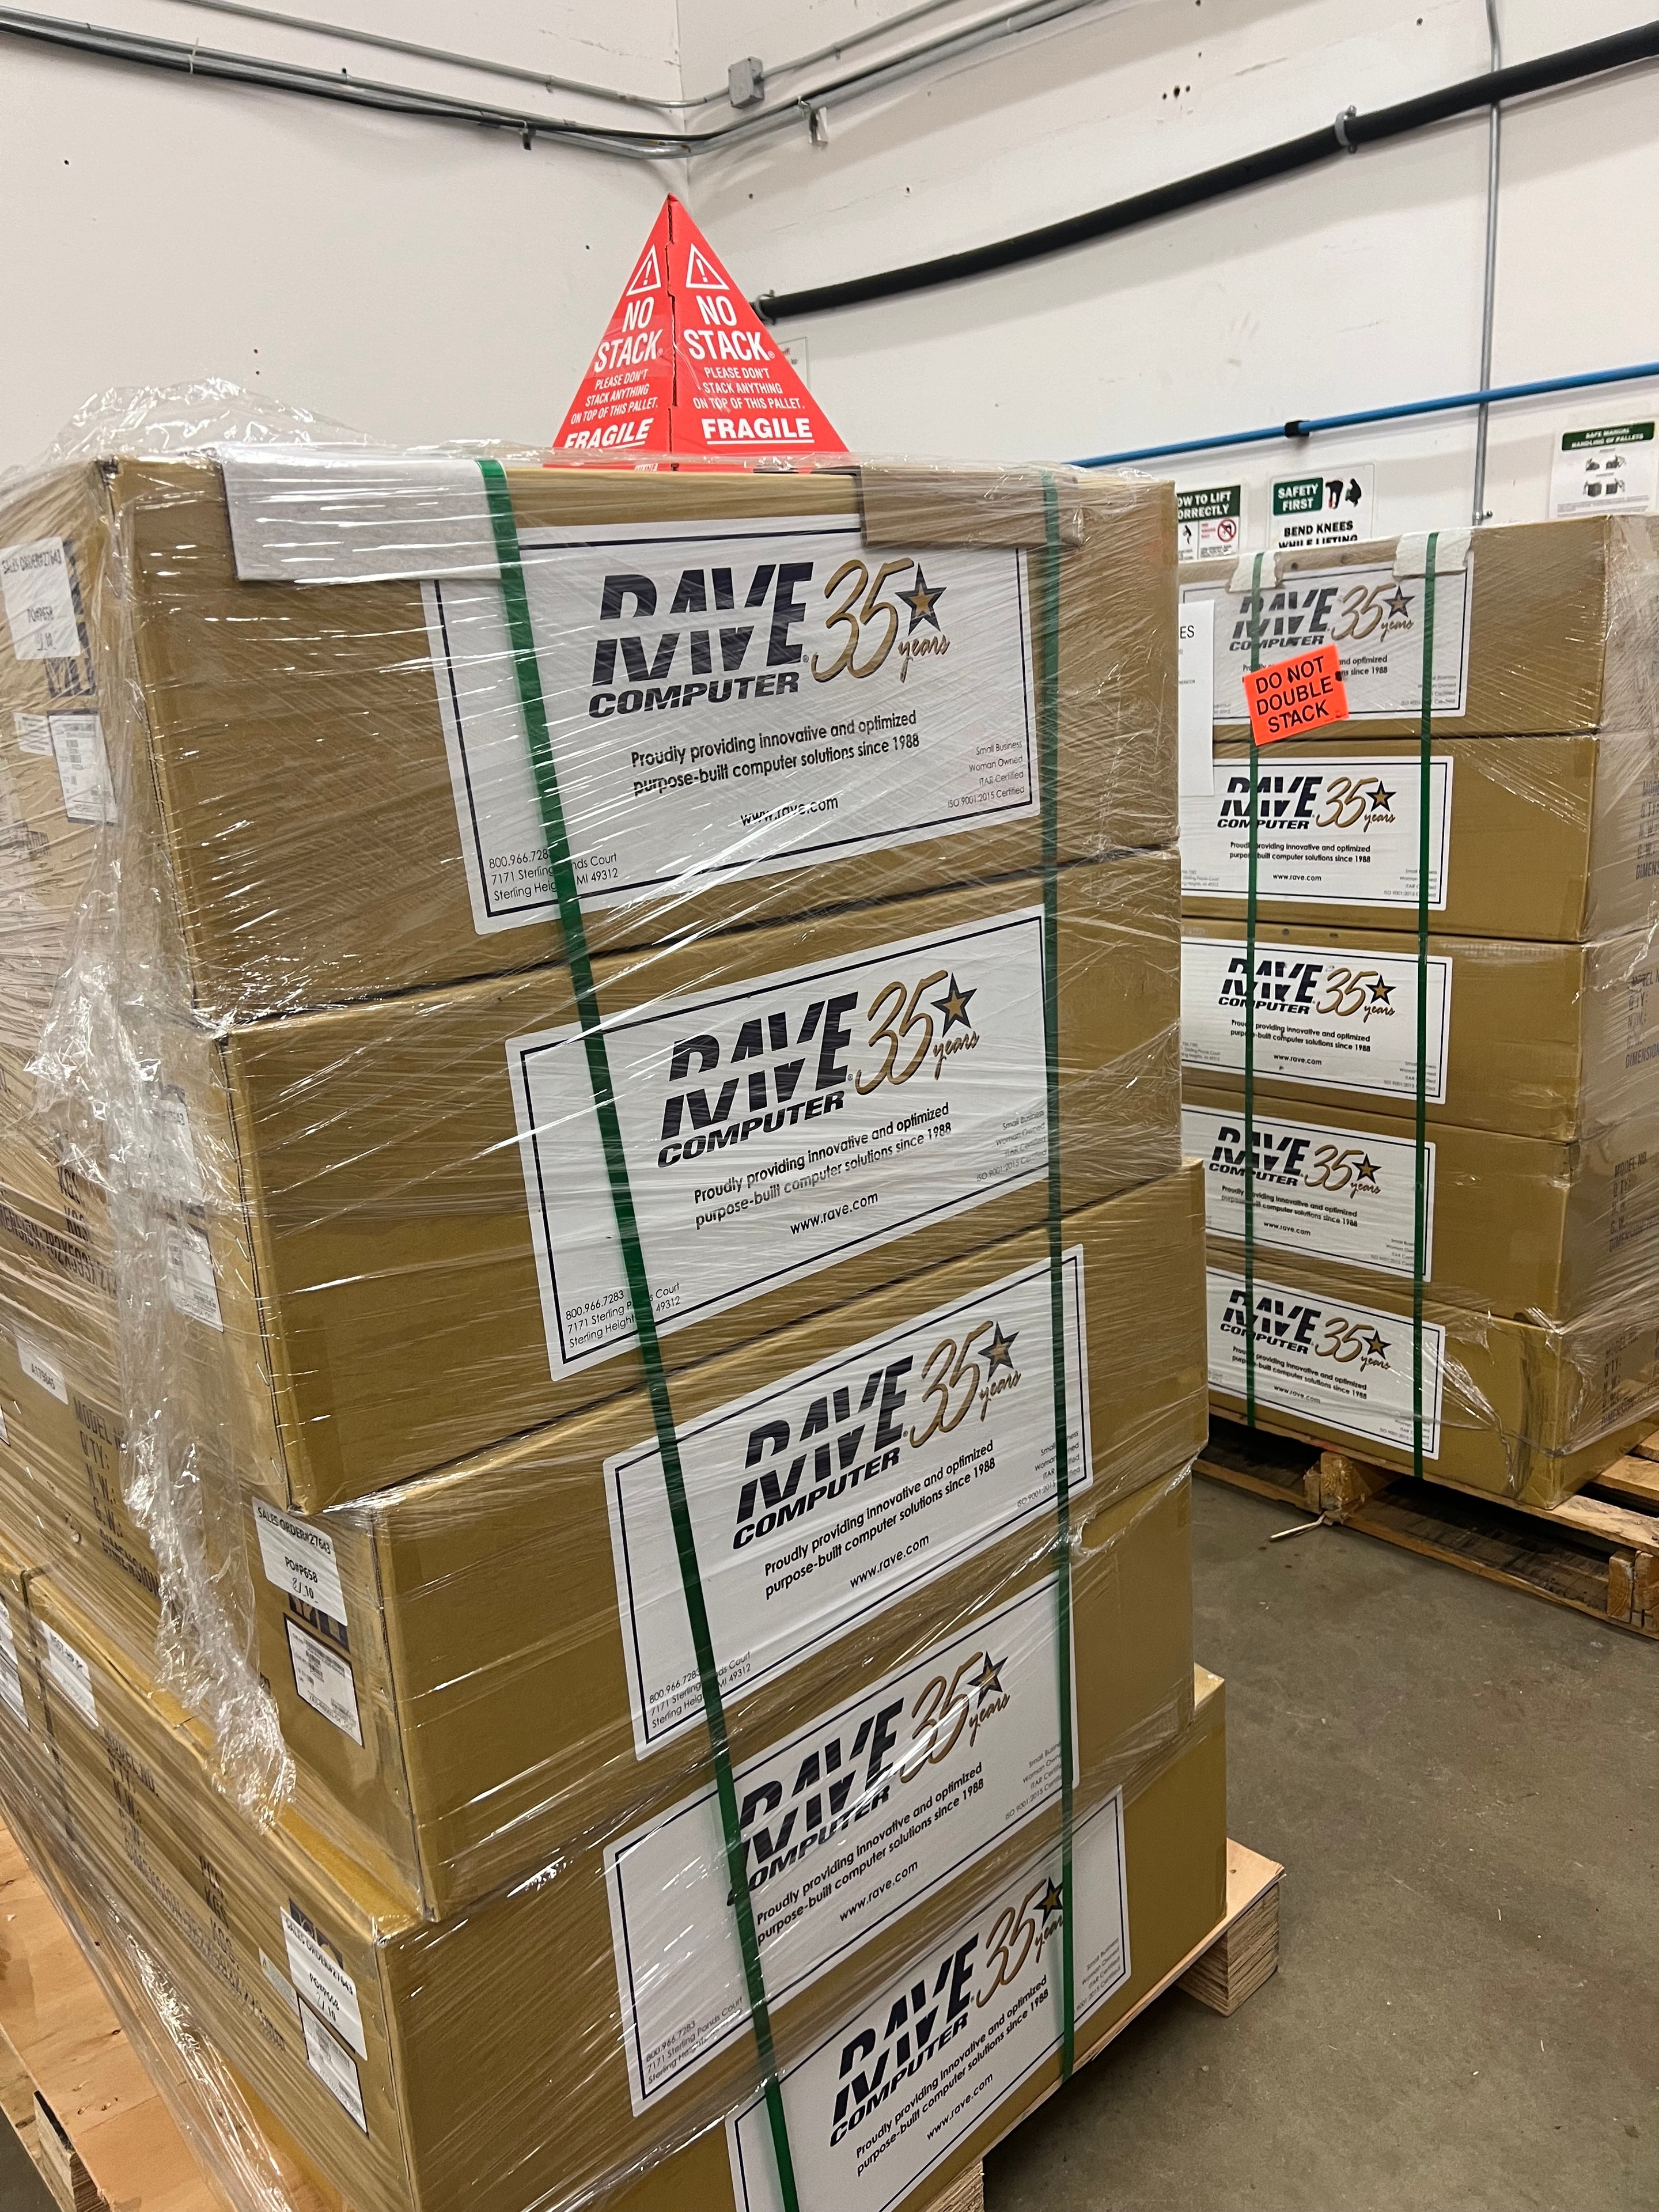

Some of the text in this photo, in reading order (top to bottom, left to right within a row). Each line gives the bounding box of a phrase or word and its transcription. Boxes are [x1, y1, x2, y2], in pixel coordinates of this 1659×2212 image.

[622, 297, 654, 332] NO
[695, 295, 737, 326] NO
[595, 369, 649, 390] PLEASE DON'T
[703, 382, 783, 394] STACK ANYTHING
[704, 367, 770, 379] PLEASE DON'T
[571, 397, 658, 425] ON TOP OF THIS PALLET.
[585, 384, 650, 407] STACK ANYTHING
[693, 398, 805, 409] ON TOP OF THIS PALLET.
[564, 418, 654, 448] FRAGILE
[701, 418, 813, 439] FRAGILE
[1571, 440, 1604, 448] HANDLING
[1615, 433, 1643, 442] PALLETS
[1585, 431, 1602, 439] SAFE
[1178, 491, 1232, 507] OW TO LIFT
[1278, 483, 1319, 499] SAFETY
[1282, 498, 1313, 512] FIRST
[1284, 521, 1353, 537] BEND KNEES
[592, 557, 914, 686] RAVE 35
[1331, 584, 1397, 641] 35
[1380, 620, 1414, 642] years
[897, 635, 950, 683] years
[1256, 656, 1324, 694] DO NOT
[589, 672, 800, 719] COMPUTER
[1256, 677, 1334, 715] DOUBLE
[1268, 700, 1330, 733] STACK
[631, 710, 916, 767] Proudly providing innovative and optimized
[976, 741, 1022, 755] Small Business
[633, 733, 919, 797] purpose-built computer solutions since 1988
[969, 755, 1022, 772] Woman Owned
[740, 797, 838, 826] www.rave.com
[948, 786, 1024, 808] ISO 9001:2015 Certified
[1316, 777, 1378, 828] 35
[1364, 813, 1396, 832] years
[491, 866, 555, 885] 7171 Sterling
[577, 868, 618, 885] MI 49312
[590, 853, 616, 866] Court
[1273, 873, 1321, 882] www.rave.com
[494, 885, 531, 901] Sterling
[1316, 967, 1378, 1016] 35
[1364, 1004, 1395, 1022] years
[661, 969, 949, 1141] RAVE 35
[933, 1030, 979, 1081] years
[1274, 1054, 1322, 1065] www.rave.com
[658, 1090, 845, 1168] COMPUTER
[694, 1102, 949, 1204] Proudly providing innovative and optimized
[1304, 1144, 1364, 1191] 35
[695, 1122, 952, 1230] purpose-built computer solutions since 1988
[1350, 1181, 1381, 1199] years
[790, 1193, 878, 1235] www.rave.com
[566, 1290, 624, 1320] 800.966.7283
[1315, 1317, 1374, 1362] 35
[1361, 1354, 1391, 1372] years
[979, 1370, 1021, 1421] years
[736, 1320, 994, 1524] RAVE 35
[732, 1446, 900, 1550] COMPUTER
[764, 1440, 994, 1577] Proudly providing innovative and optimized
[257, 1507, 331, 1555] SALES ORDER#27643
[765, 1457, 995, 1600] purpose-built computer solutions since 1988
[285, 1555, 318, 1583] PO#P658
[850, 1535, 929, 1588] www.rave.com
[900, 1652, 983, 1783] 35
[969, 1694, 1010, 1747] years
[757, 1762, 982, 1926] Proudly providing innovative and optimized
[757, 1778, 984, 1946] purpose-built computer solutions since 1988
[840, 1860, 918, 1922] www.rave.com
[832, 1878, 1046, 2127] RAVE 35
[830, 2012, 968, 2147] COMPUTER
[856, 1974, 1047, 2159] Proudly providing innovative and optimized
[857, 1988, 1048, 2177] purpose-built computer solutions since 1988
[926, 2073, 993, 2141] www.rave.com
